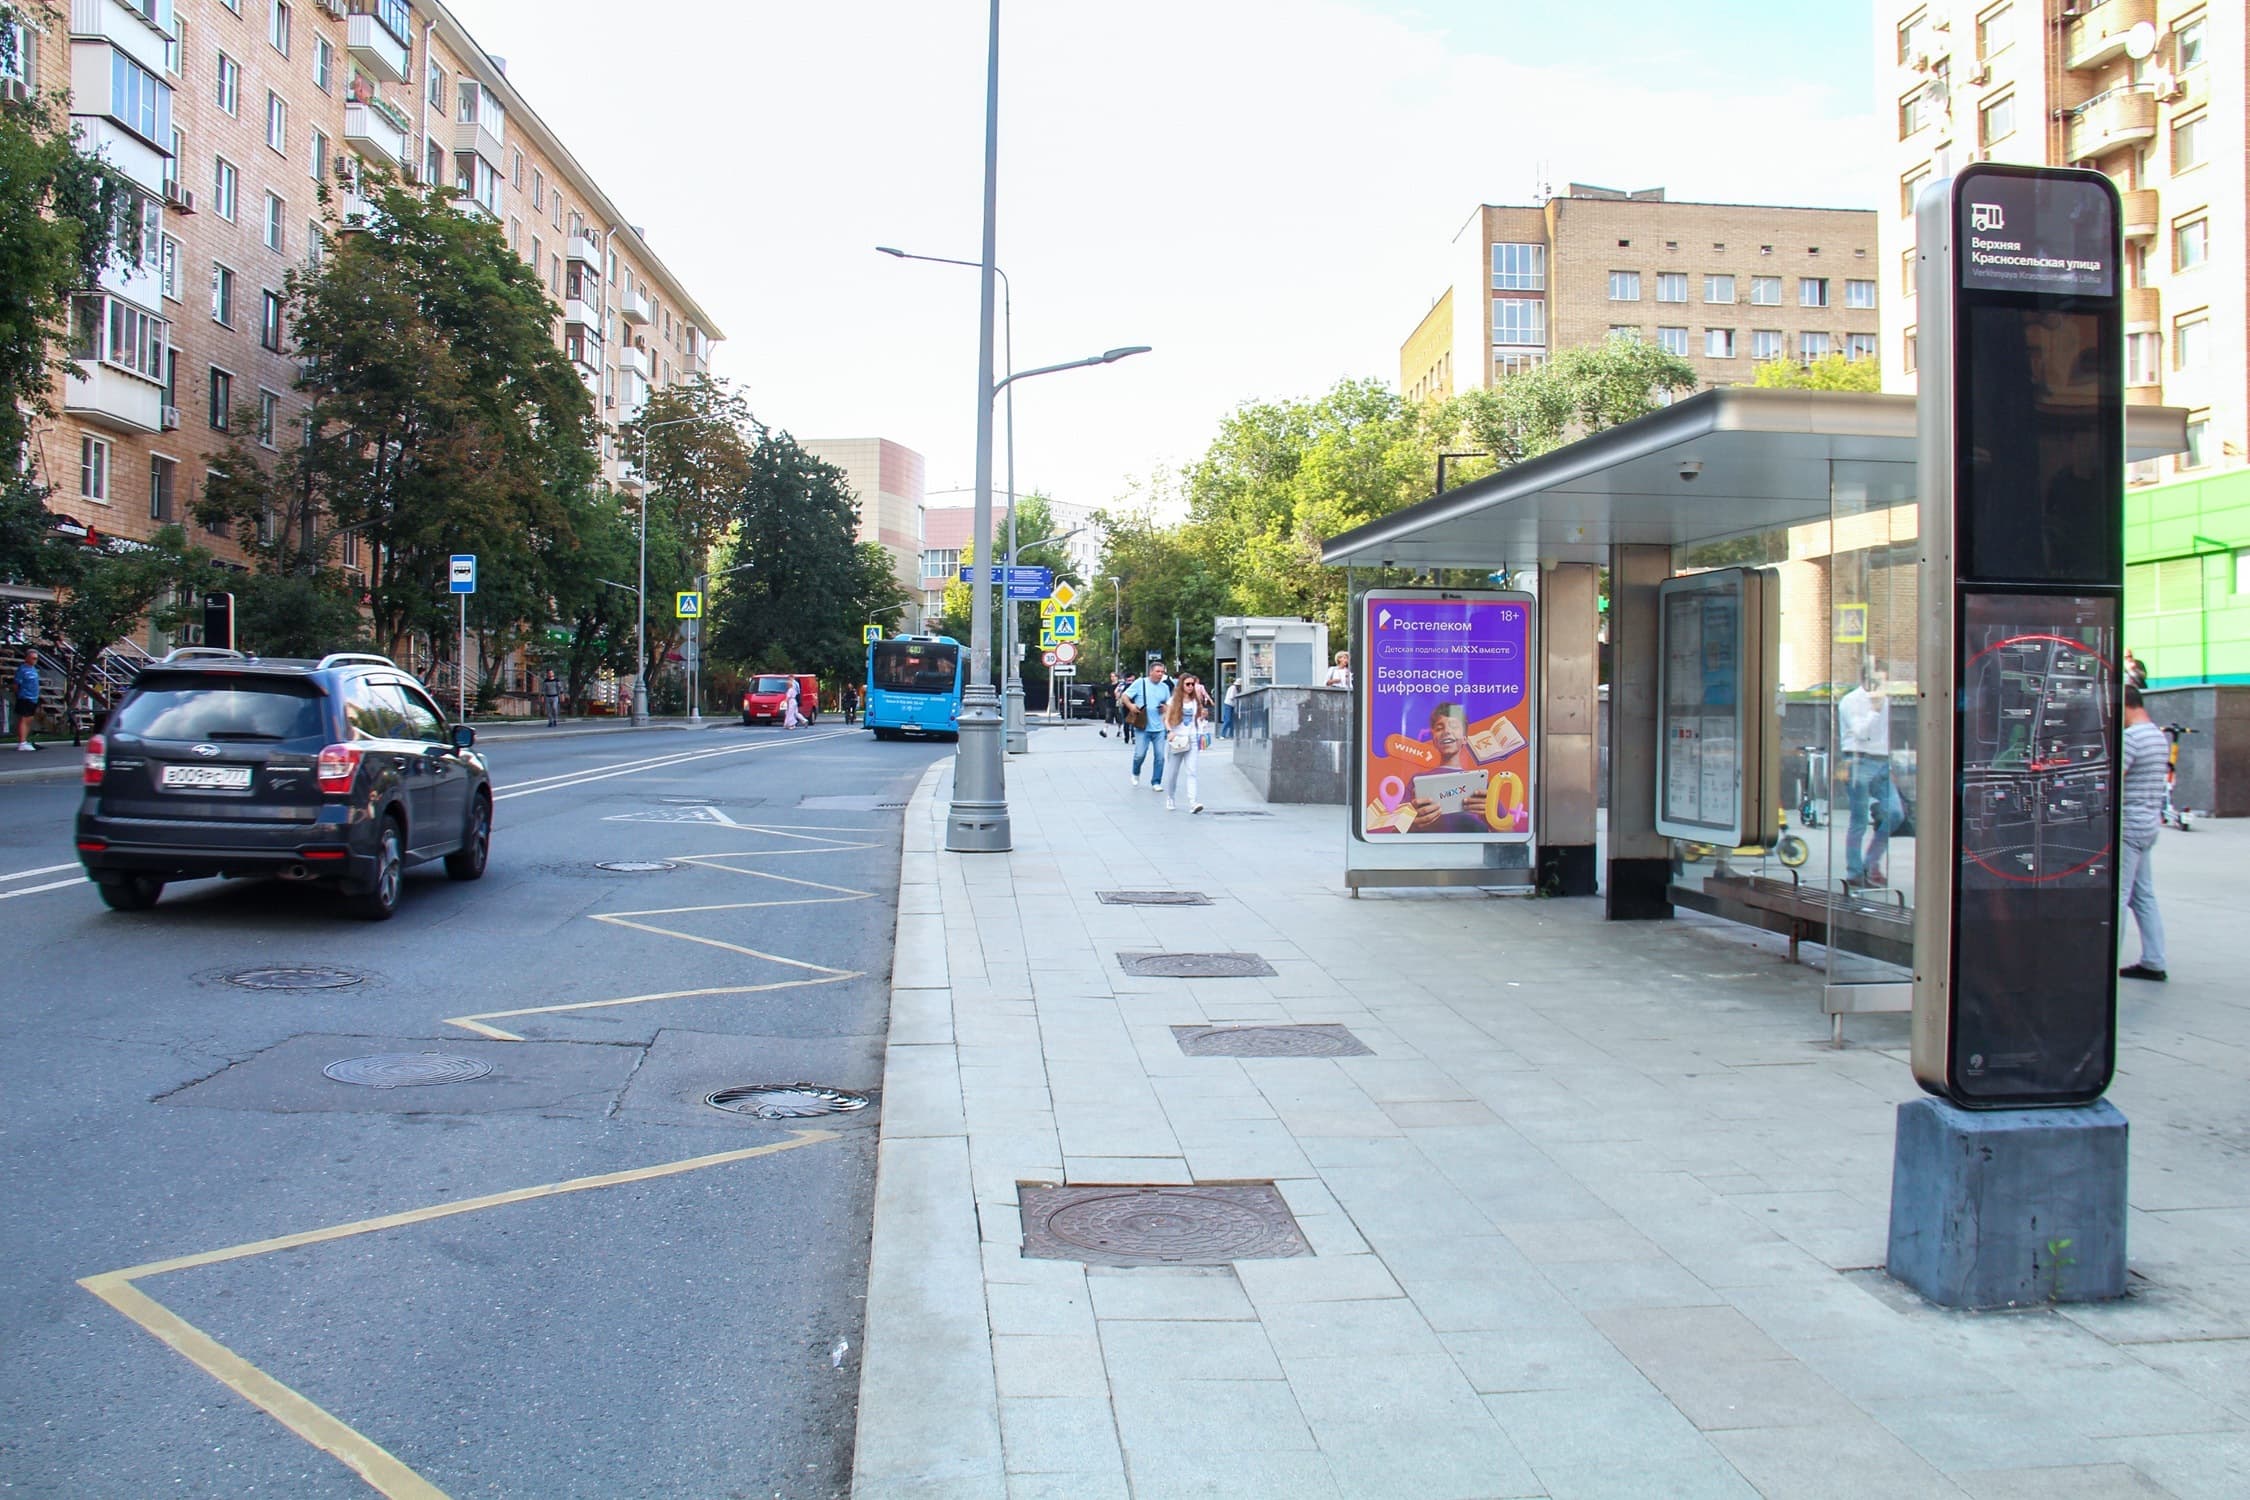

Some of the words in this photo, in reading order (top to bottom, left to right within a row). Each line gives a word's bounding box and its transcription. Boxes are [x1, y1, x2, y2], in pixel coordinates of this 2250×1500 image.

[1971, 237, 2021, 251] Верхняя
[1971, 252, 2065, 269] Красносельская
[2065, 258, 2101, 271] улица
[1500, 610, 1519, 622] 18+
[1393, 619, 1473, 632] Ростелеком
[1384, 645, 1414, 653] Детская
[1415, 646, 1449, 655] подписка
[1378, 666, 1464, 680] Безопасное
[1378, 681, 1450, 696] цифровое
[1454, 683, 1519, 696] развитие
[1394, 742, 1424, 758] WINK
